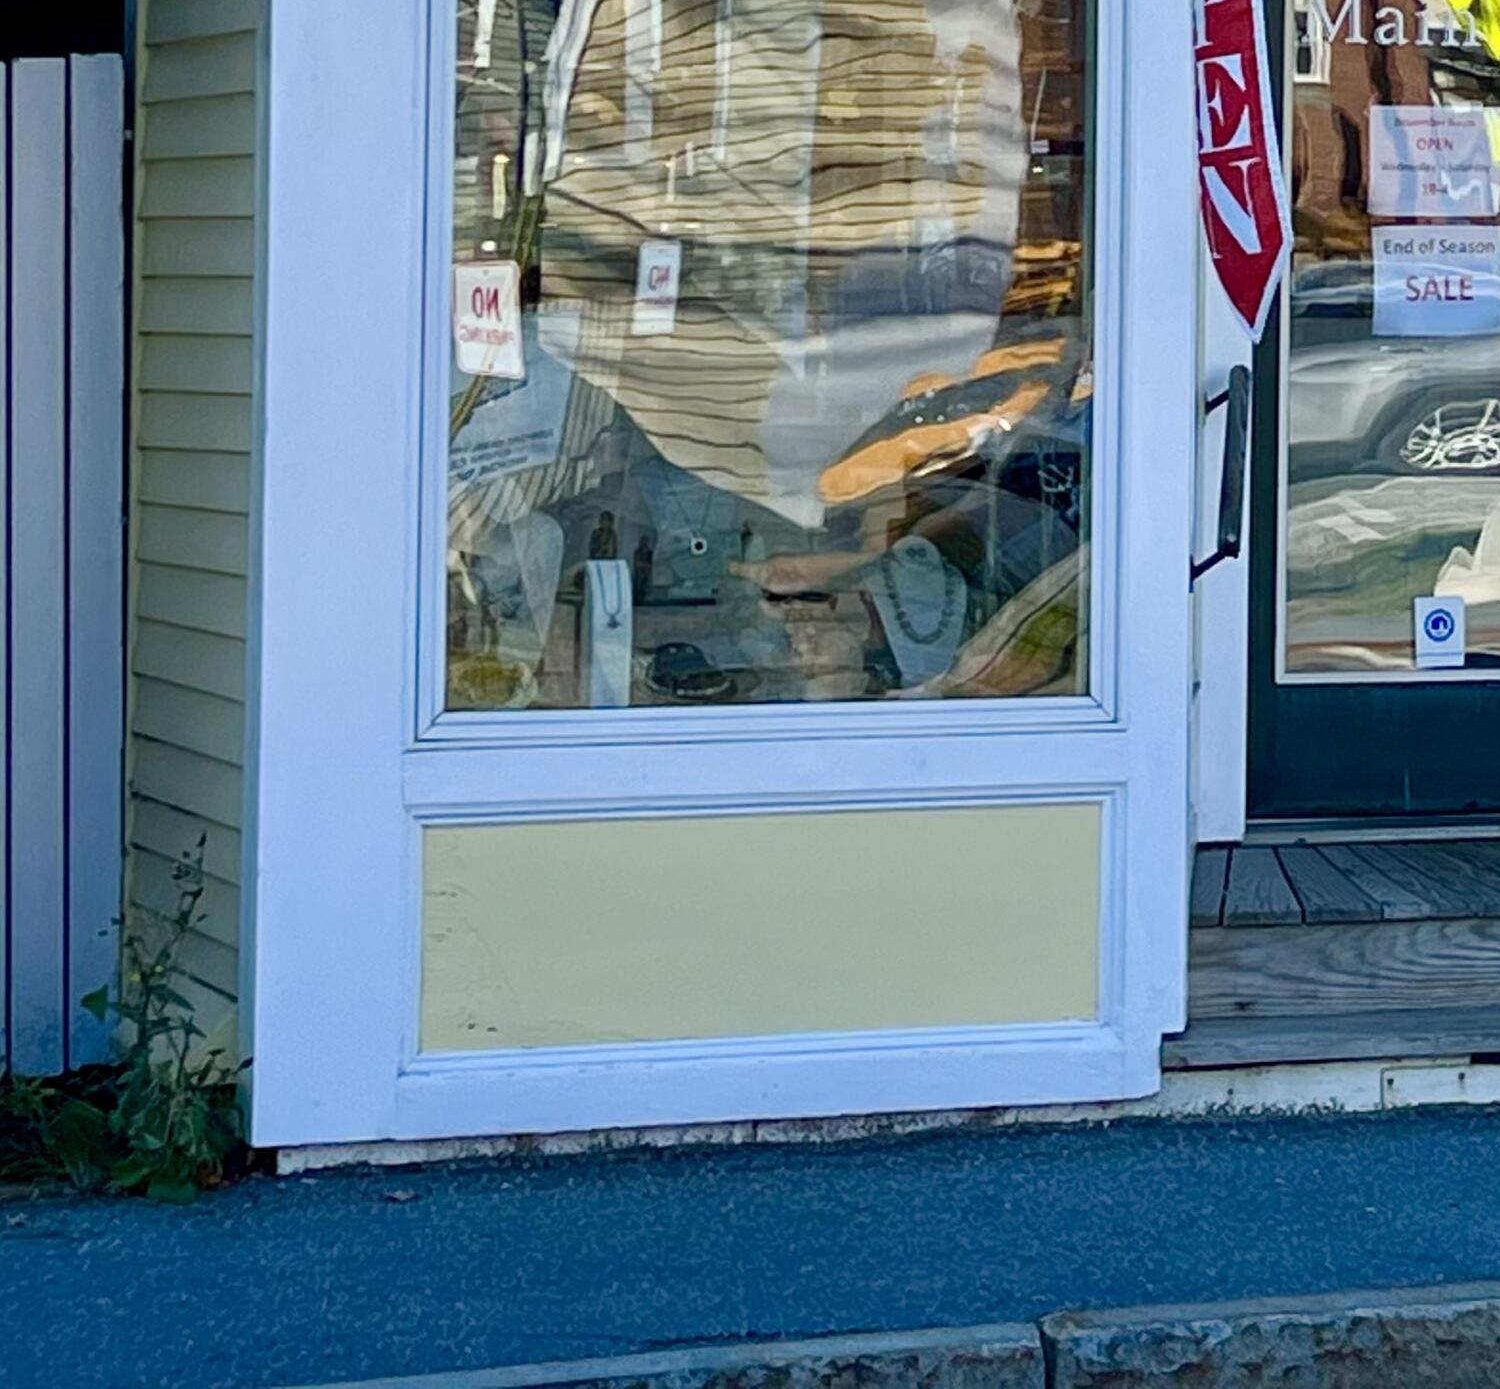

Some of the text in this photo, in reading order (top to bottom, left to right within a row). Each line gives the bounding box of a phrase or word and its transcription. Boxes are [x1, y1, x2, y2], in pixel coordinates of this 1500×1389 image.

[1383, 238, 1496, 255] End of Season
[1405, 275, 1474, 302] SALE
